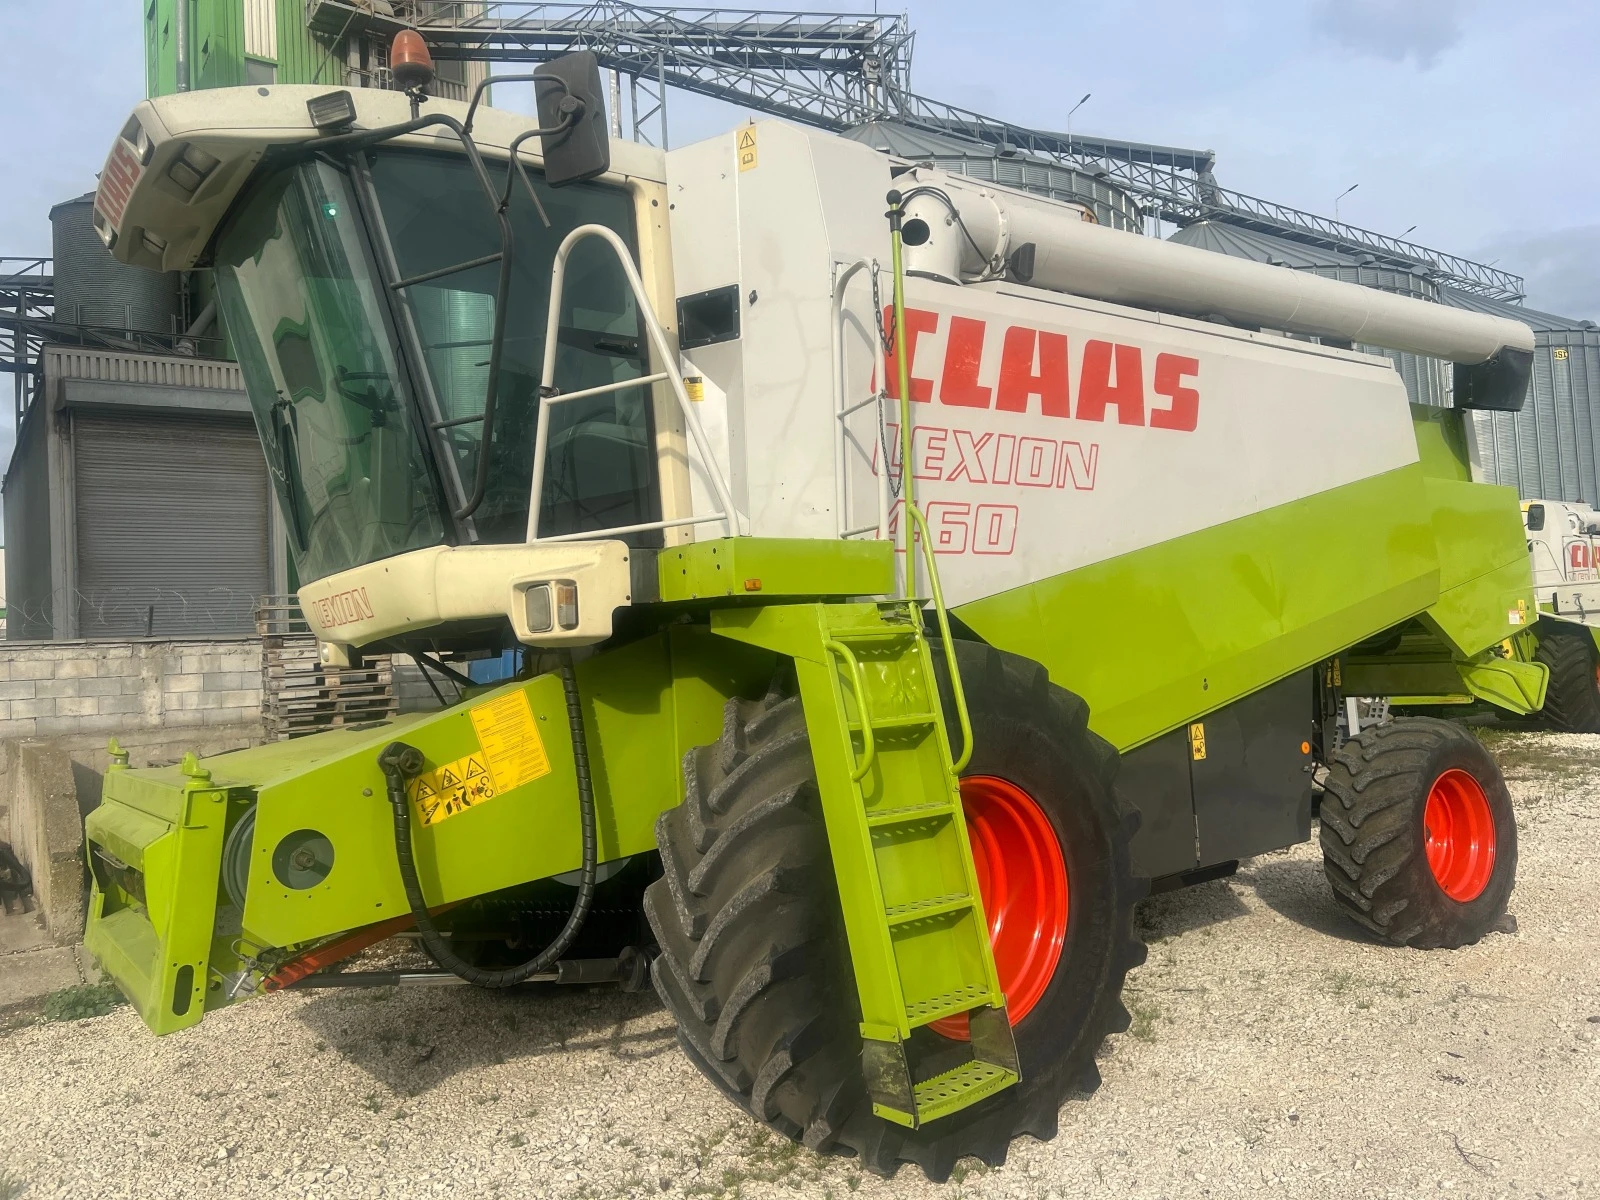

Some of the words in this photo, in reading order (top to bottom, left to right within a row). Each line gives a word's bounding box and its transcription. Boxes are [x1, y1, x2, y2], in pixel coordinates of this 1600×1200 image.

[97, 138, 141, 229] CLAAS
[870, 303, 1200, 432] CLAAS
[871, 422, 1099, 491] LEXION
[875, 498, 1019, 556] 460
[312, 586, 375, 629] LEXION
